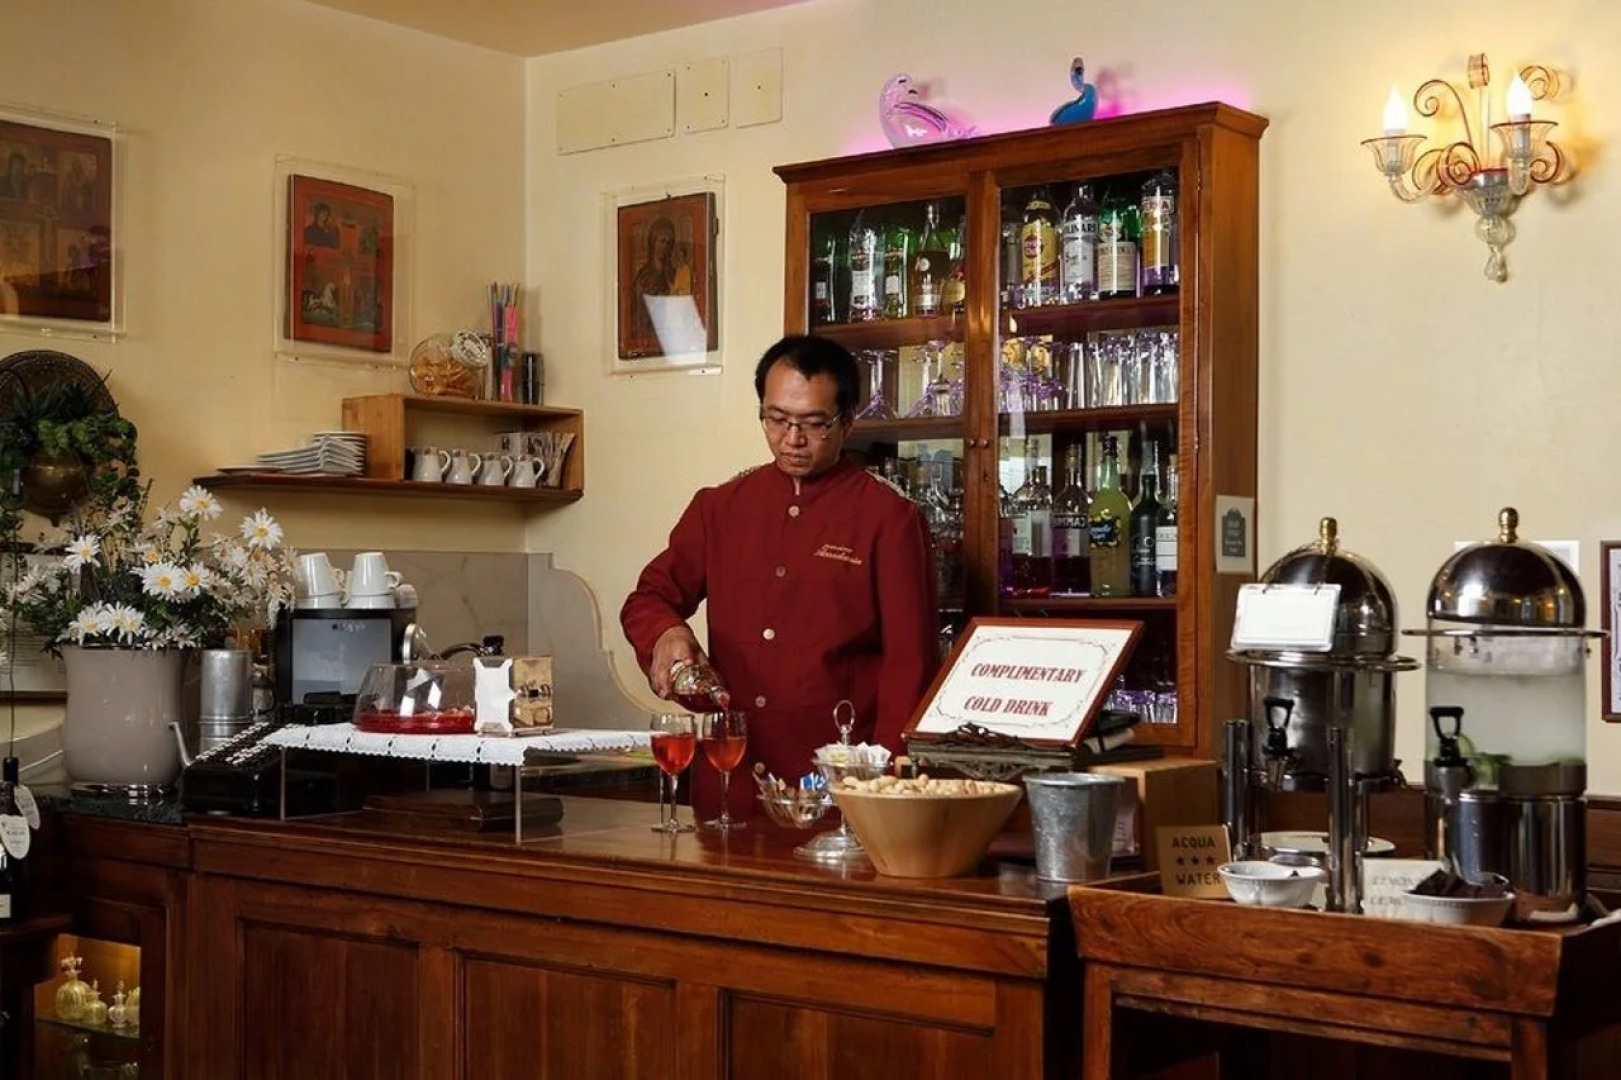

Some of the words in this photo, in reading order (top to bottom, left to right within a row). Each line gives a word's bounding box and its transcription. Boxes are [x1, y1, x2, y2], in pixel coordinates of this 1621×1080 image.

[970, 663, 1086, 682] COMPLIMENTARY
[964, 695, 1003, 713] COLD
[1003, 697, 1053, 716] DRINK
[1172, 836, 1216, 848] ACQUA
[1175, 872, 1221, 885] WATER
